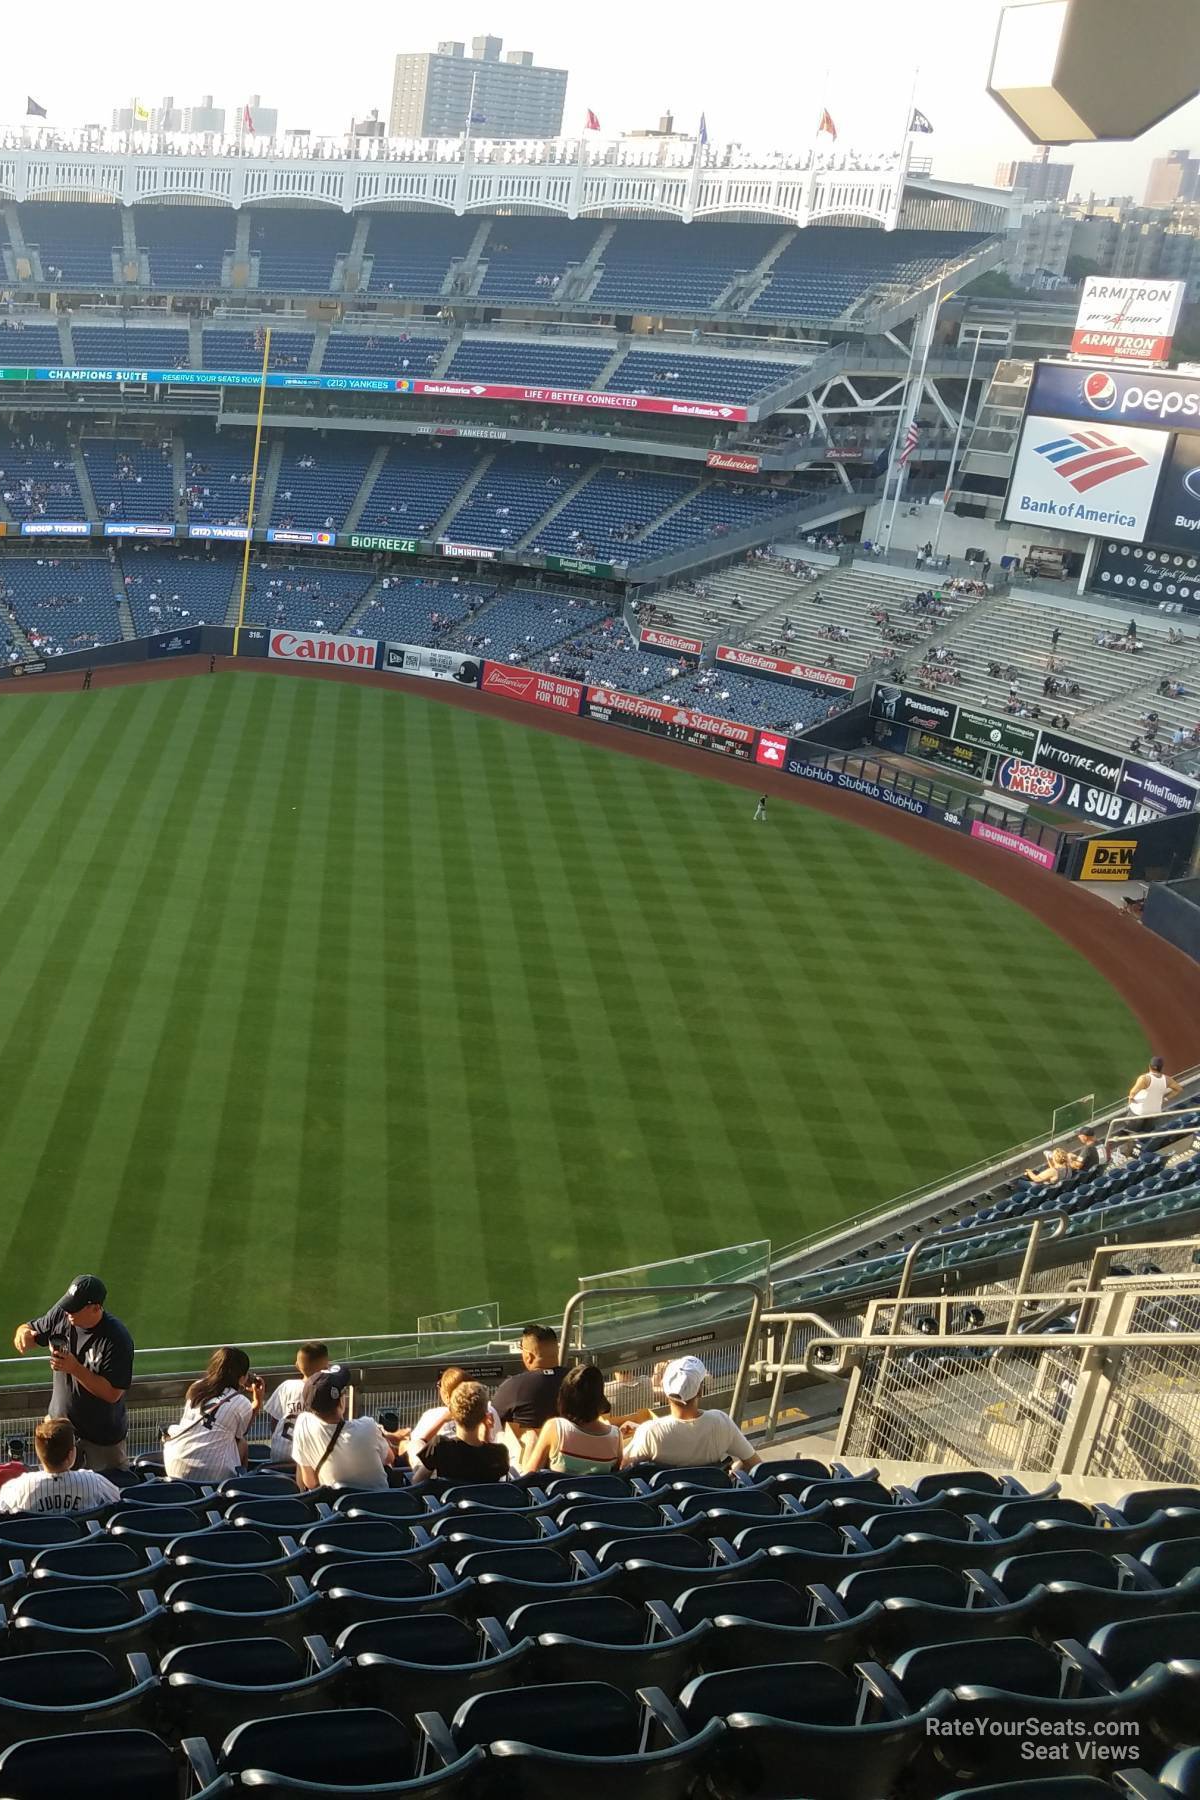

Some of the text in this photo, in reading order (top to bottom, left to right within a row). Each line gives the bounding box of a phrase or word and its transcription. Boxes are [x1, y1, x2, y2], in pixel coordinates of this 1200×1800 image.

[1087, 286, 1171, 301] ARMITRON
[1080, 334, 1157, 350] ARMITRON
[48, 370, 148, 381] CHAMPIONS SUITE
[162, 374, 194, 382] RESERVE
[196, 374, 216, 383] YOUR
[217, 375, 240, 383] SEATS
[326, 379, 388, 389] (212) YANKEES
[446, 386, 470, 395] America
[524, 390, 542, 399] LIFE
[551, 392, 583, 402] BETTER
[586, 394, 638, 407] CONNECTED
[459, 428, 488, 438] YANKEES
[489, 430, 507, 439] CLUB
[709, 454, 757, 471] Budweiser
[1020, 496, 1137, 527] Bank of America
[25, 525, 53, 533] GROUP
[271, 633, 374, 665] Canon
[537, 679, 580, 698] THIS BUD'S
[535, 690, 570, 708] FOR YOU.
[905, 697, 950, 718] Panasonic
[788, 760, 833, 783] StubHub
[1038, 743, 1119, 782] NITTOTIRE.COM
[1008, 760, 1057, 785] Jersey
[837, 773, 880, 797] StubHub
[883, 789, 923, 814] StubHub
[1066, 783, 1080, 808] A
[1084, 788, 1121, 820] SUB
[943, 811, 958, 825] 399
[985, 830, 1047, 864] DUNKIN' DONUTS
[37, 1494, 82, 1512] JUDGE
